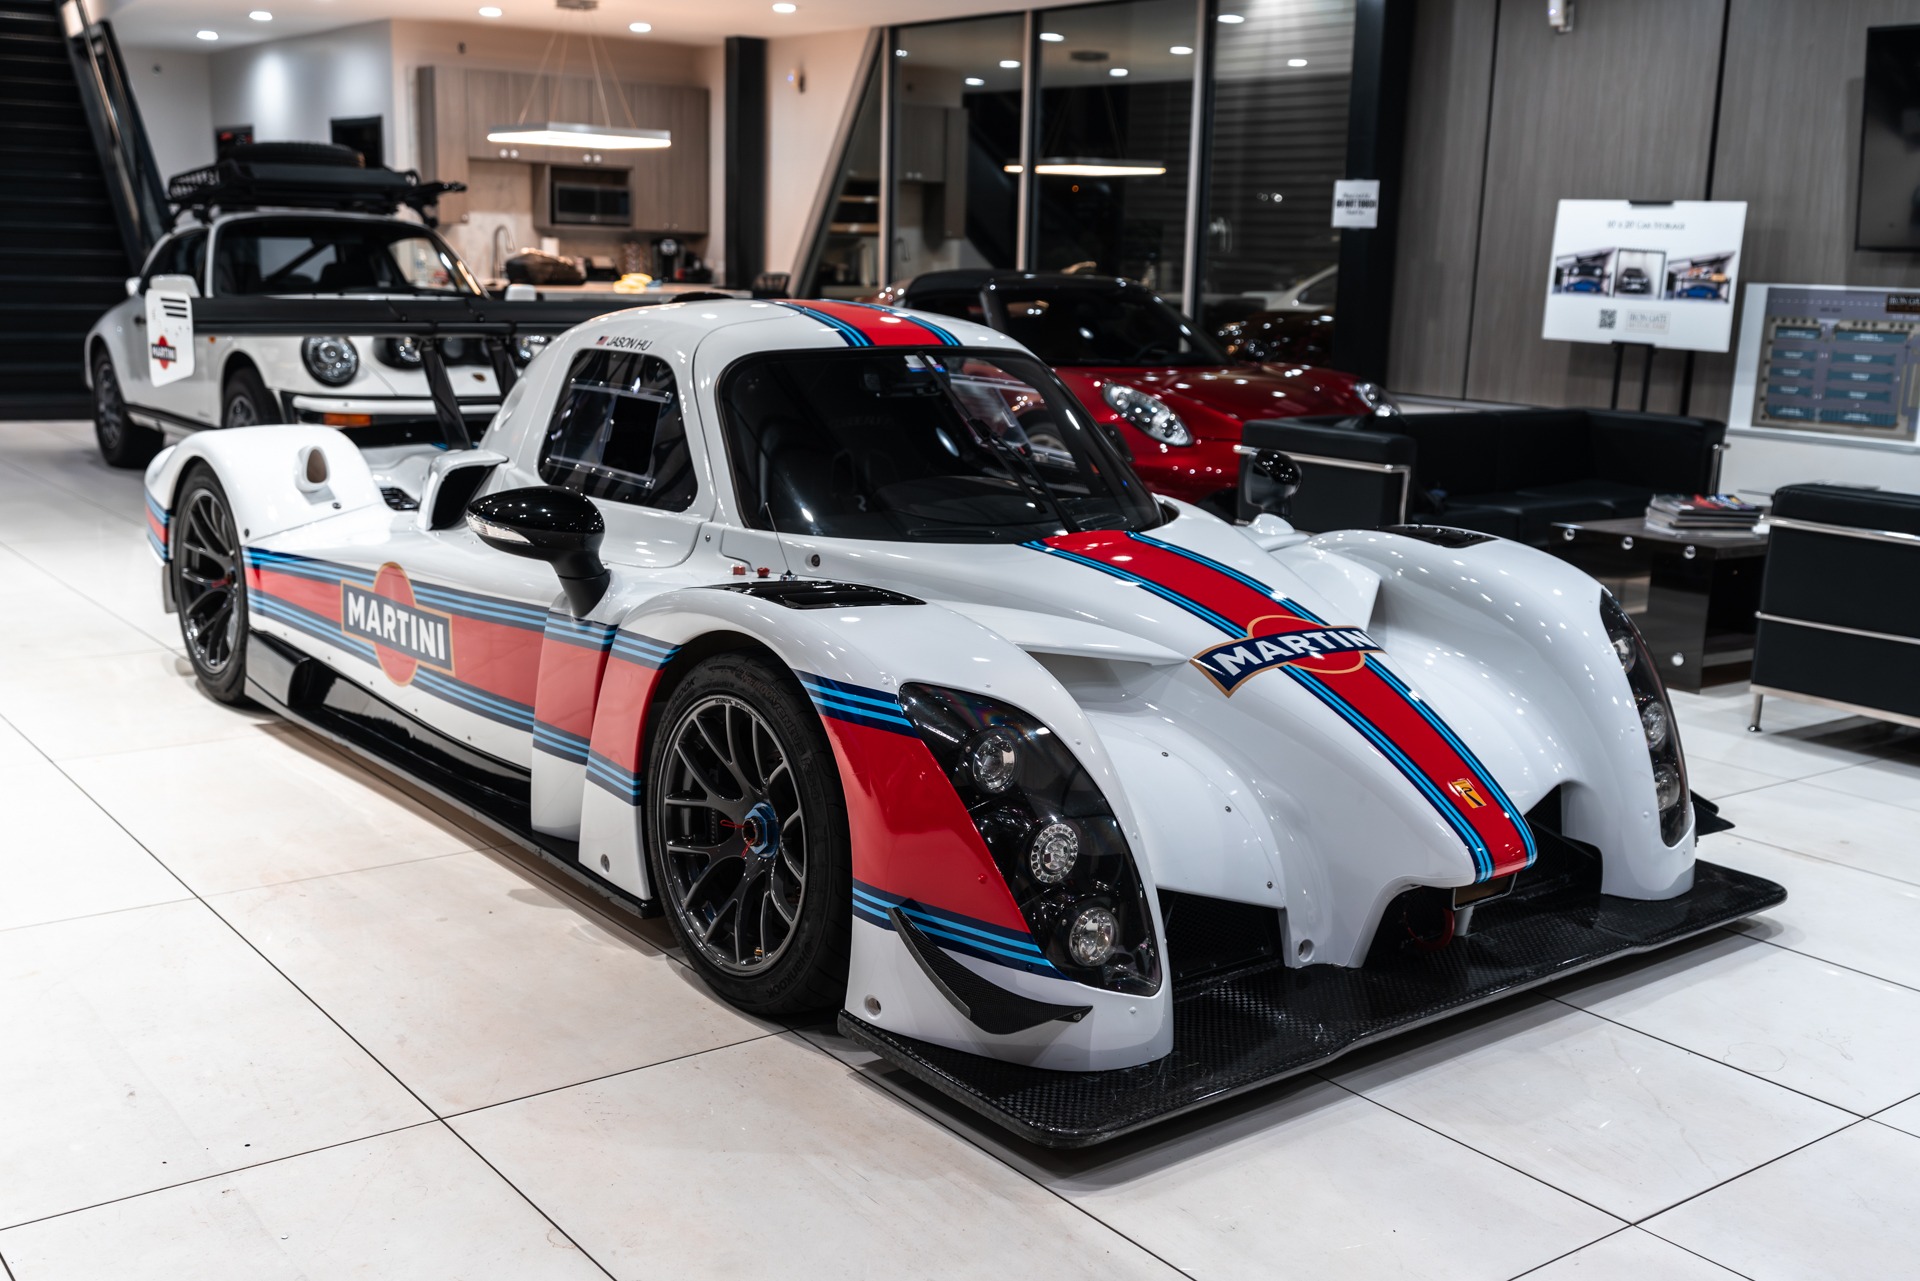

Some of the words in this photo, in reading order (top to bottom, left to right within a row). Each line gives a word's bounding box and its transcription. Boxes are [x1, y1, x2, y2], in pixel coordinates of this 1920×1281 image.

[606, 336, 638, 348] JASON
[634, 338, 653, 351] HU
[347, 592, 446, 661] MARTINI
[1212, 630, 1380, 677] MARTIN
